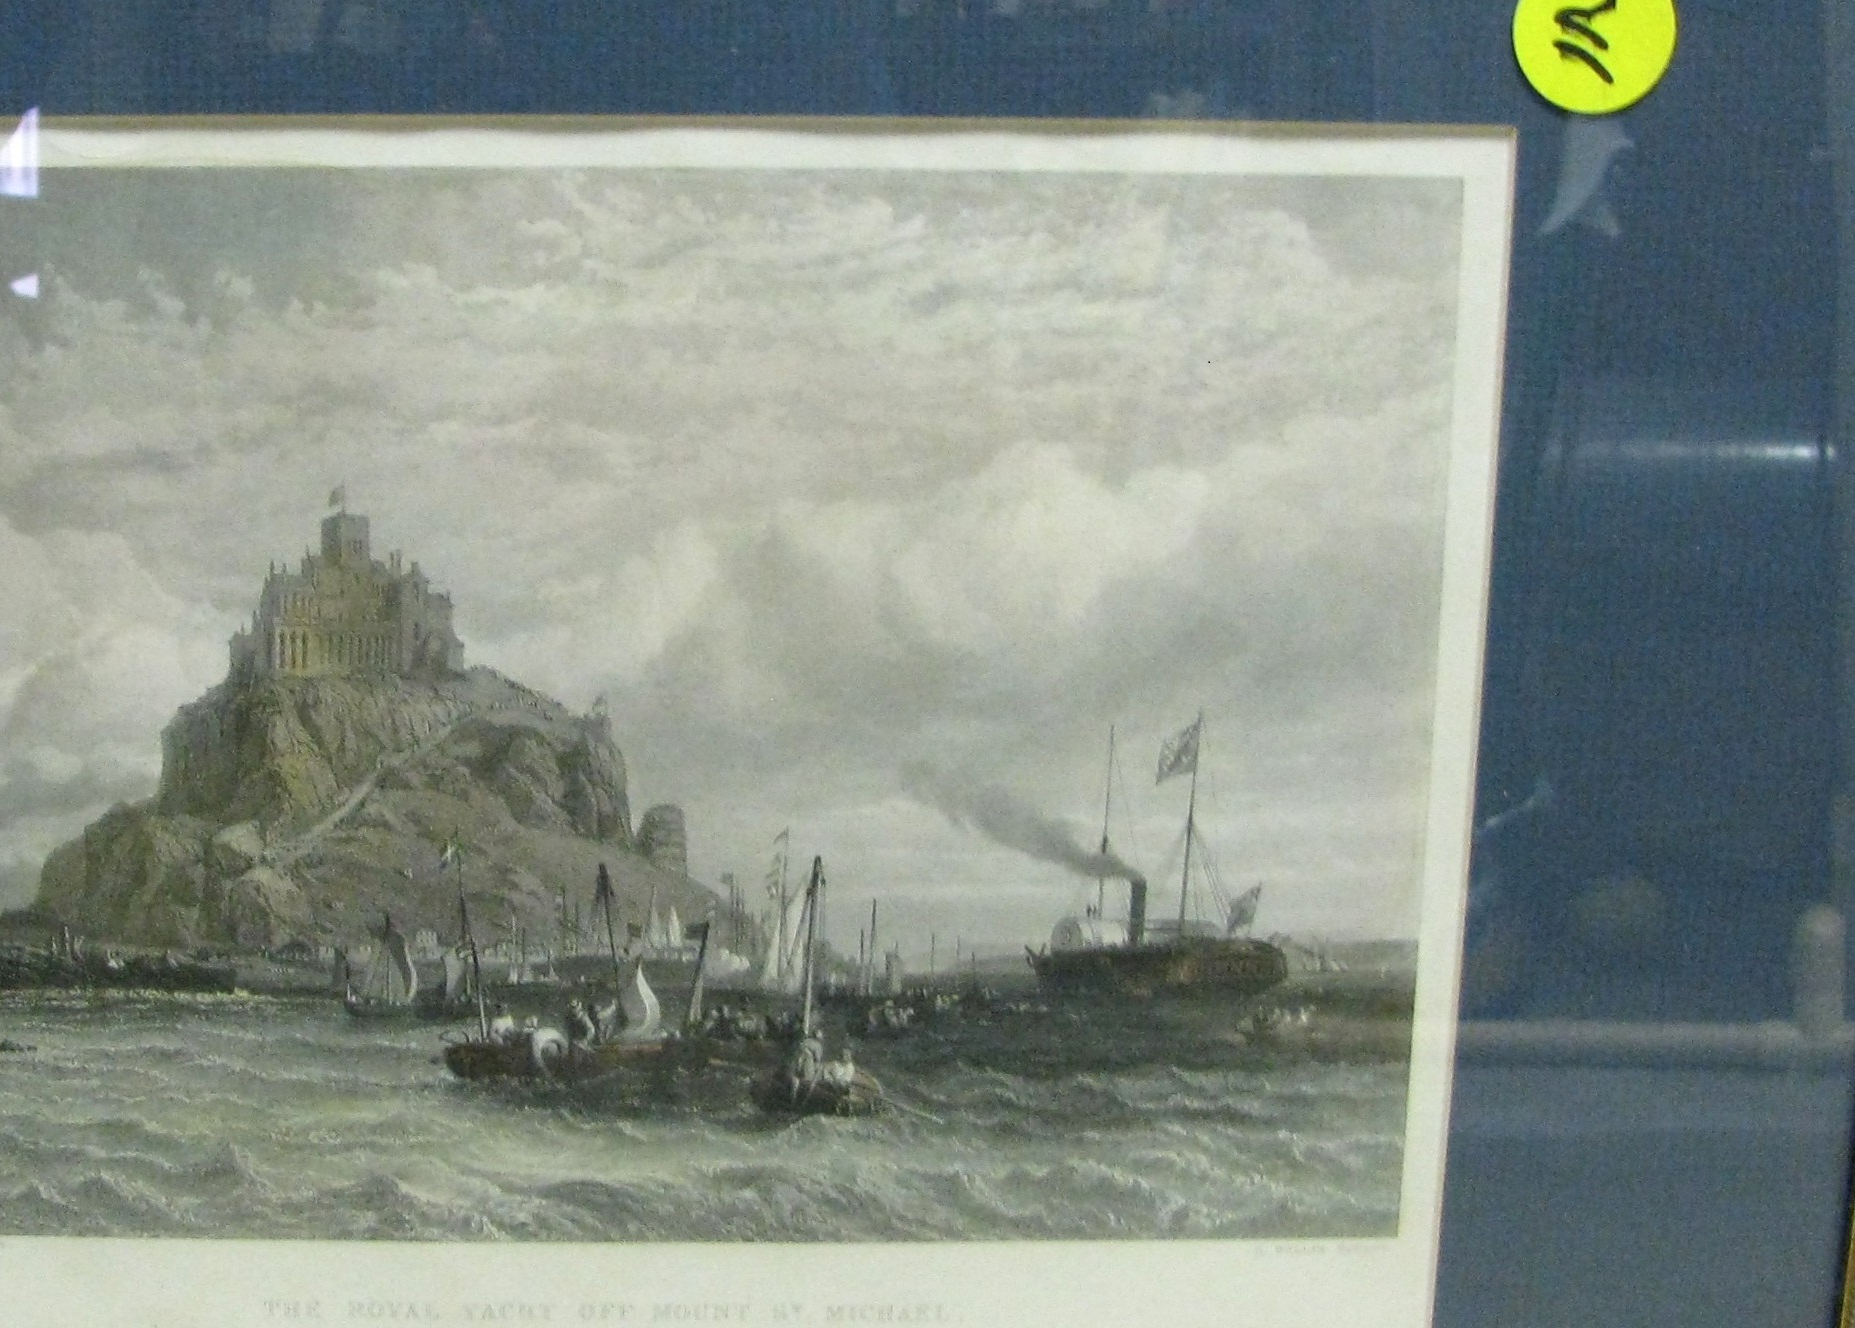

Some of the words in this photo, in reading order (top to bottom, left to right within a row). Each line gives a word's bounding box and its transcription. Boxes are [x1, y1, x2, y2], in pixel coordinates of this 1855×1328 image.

[263, 1299, 322, 1320] THE
[347, 1299, 442, 1321] ROYAL
[462, 1302, 557, 1322] YACHT
[577, 1301, 636, 1322] OFF
[652, 1302, 751, 1322] MOUNT
